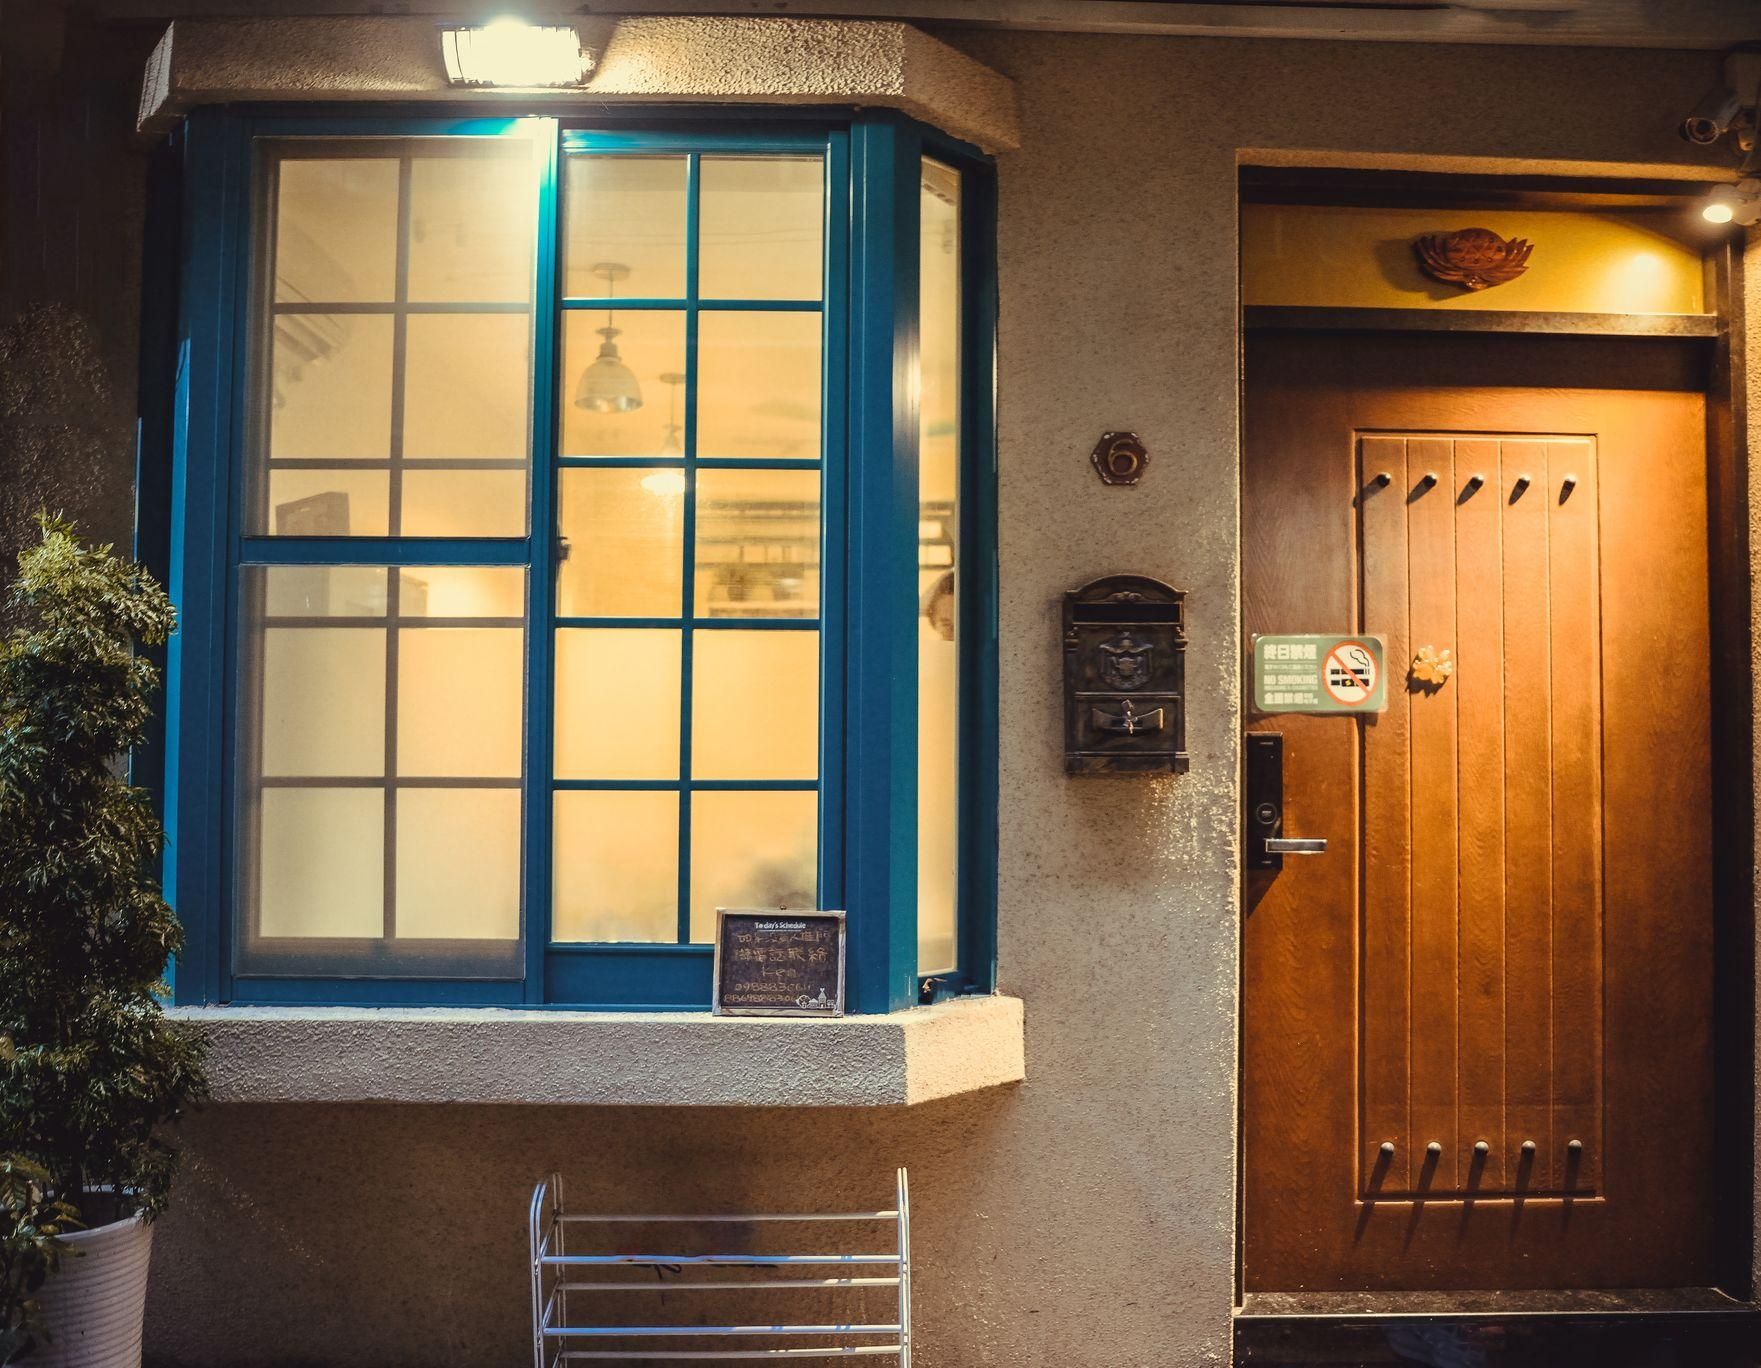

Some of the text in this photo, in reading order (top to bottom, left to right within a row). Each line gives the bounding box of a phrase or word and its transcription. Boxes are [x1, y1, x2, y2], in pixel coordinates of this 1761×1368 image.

[1108, 439, 1138, 475] 6
[1263, 675, 1318, 685] NO SMOKING
[779, 922, 806, 930] Schedule
